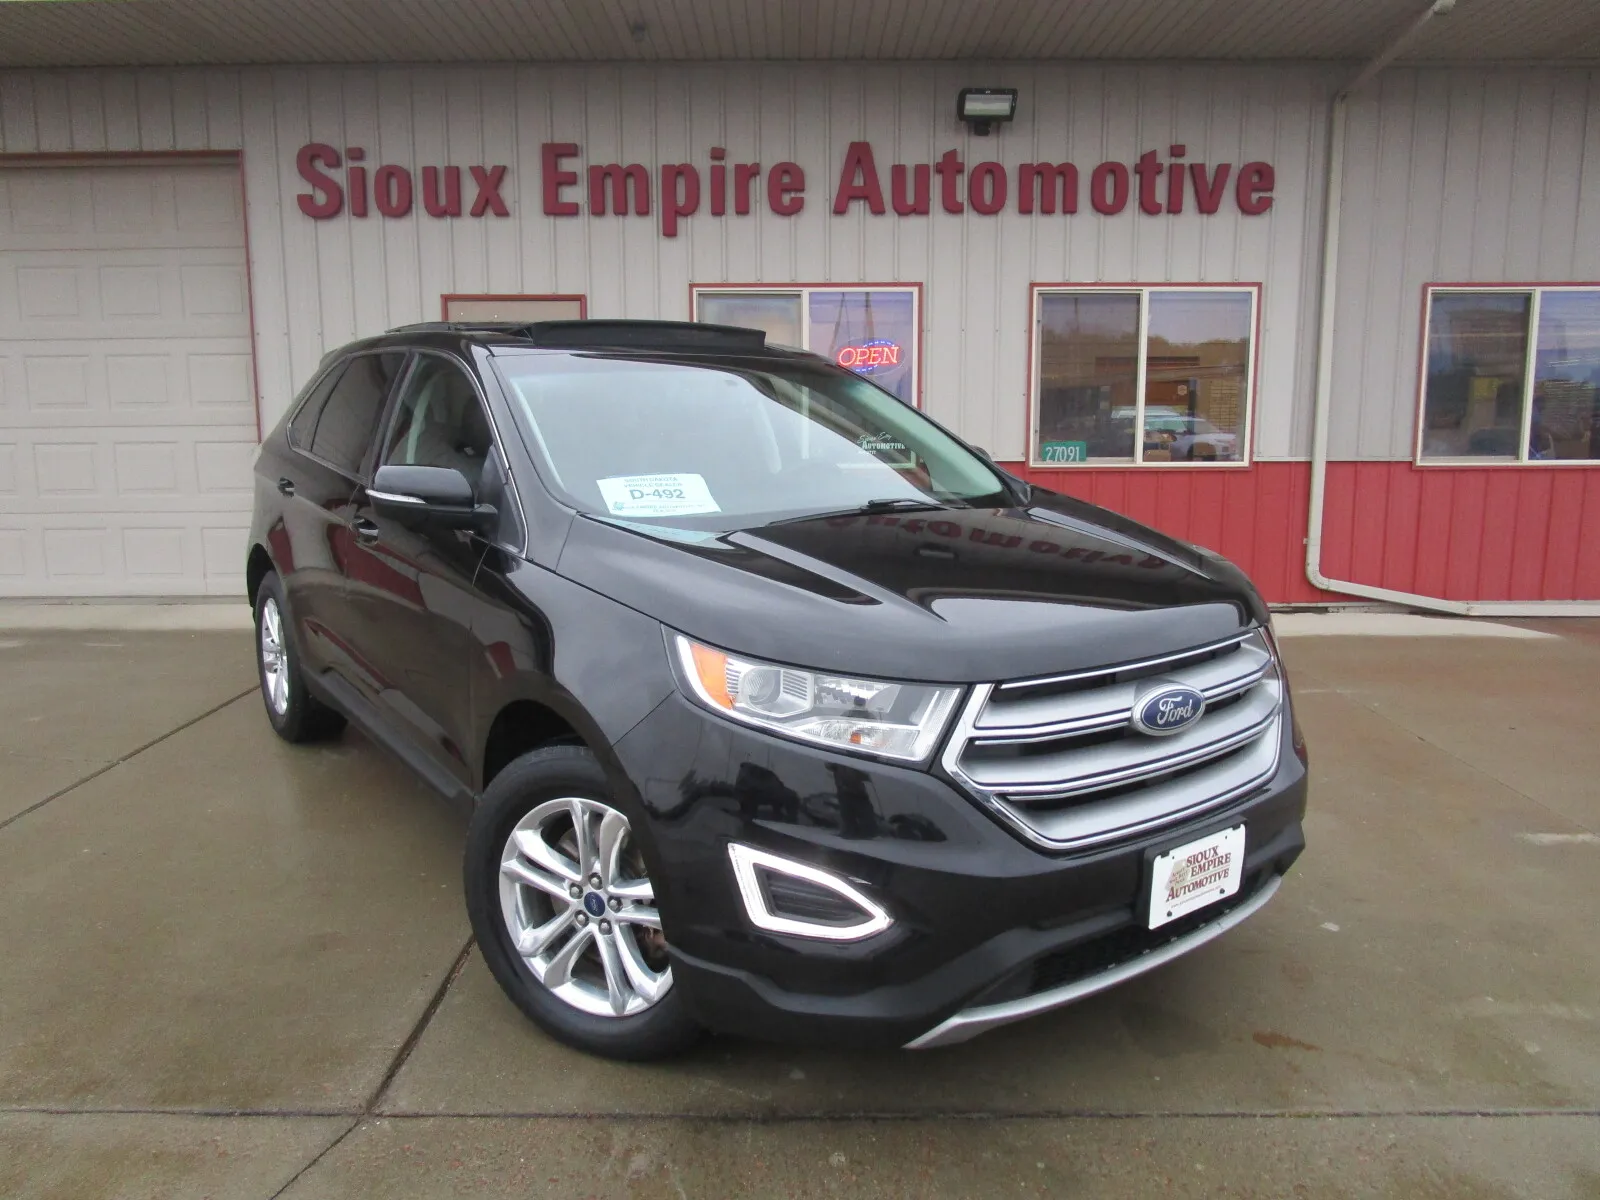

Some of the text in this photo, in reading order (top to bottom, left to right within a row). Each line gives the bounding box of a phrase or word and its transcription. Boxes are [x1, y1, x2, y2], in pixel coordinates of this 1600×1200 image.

[297, 141, 1275, 237] Sioux Empire Automotive
[838, 346, 900, 366] OPEN
[1045, 446, 1080, 462] 27091
[629, 488, 686, 500] D-492
[1157, 696, 1194, 724] Ford
[1186, 845, 1219, 868] SIOUX
[1191, 852, 1231, 878] EMPIRE
[1166, 867, 1230, 903] AUTOMOTIVE
